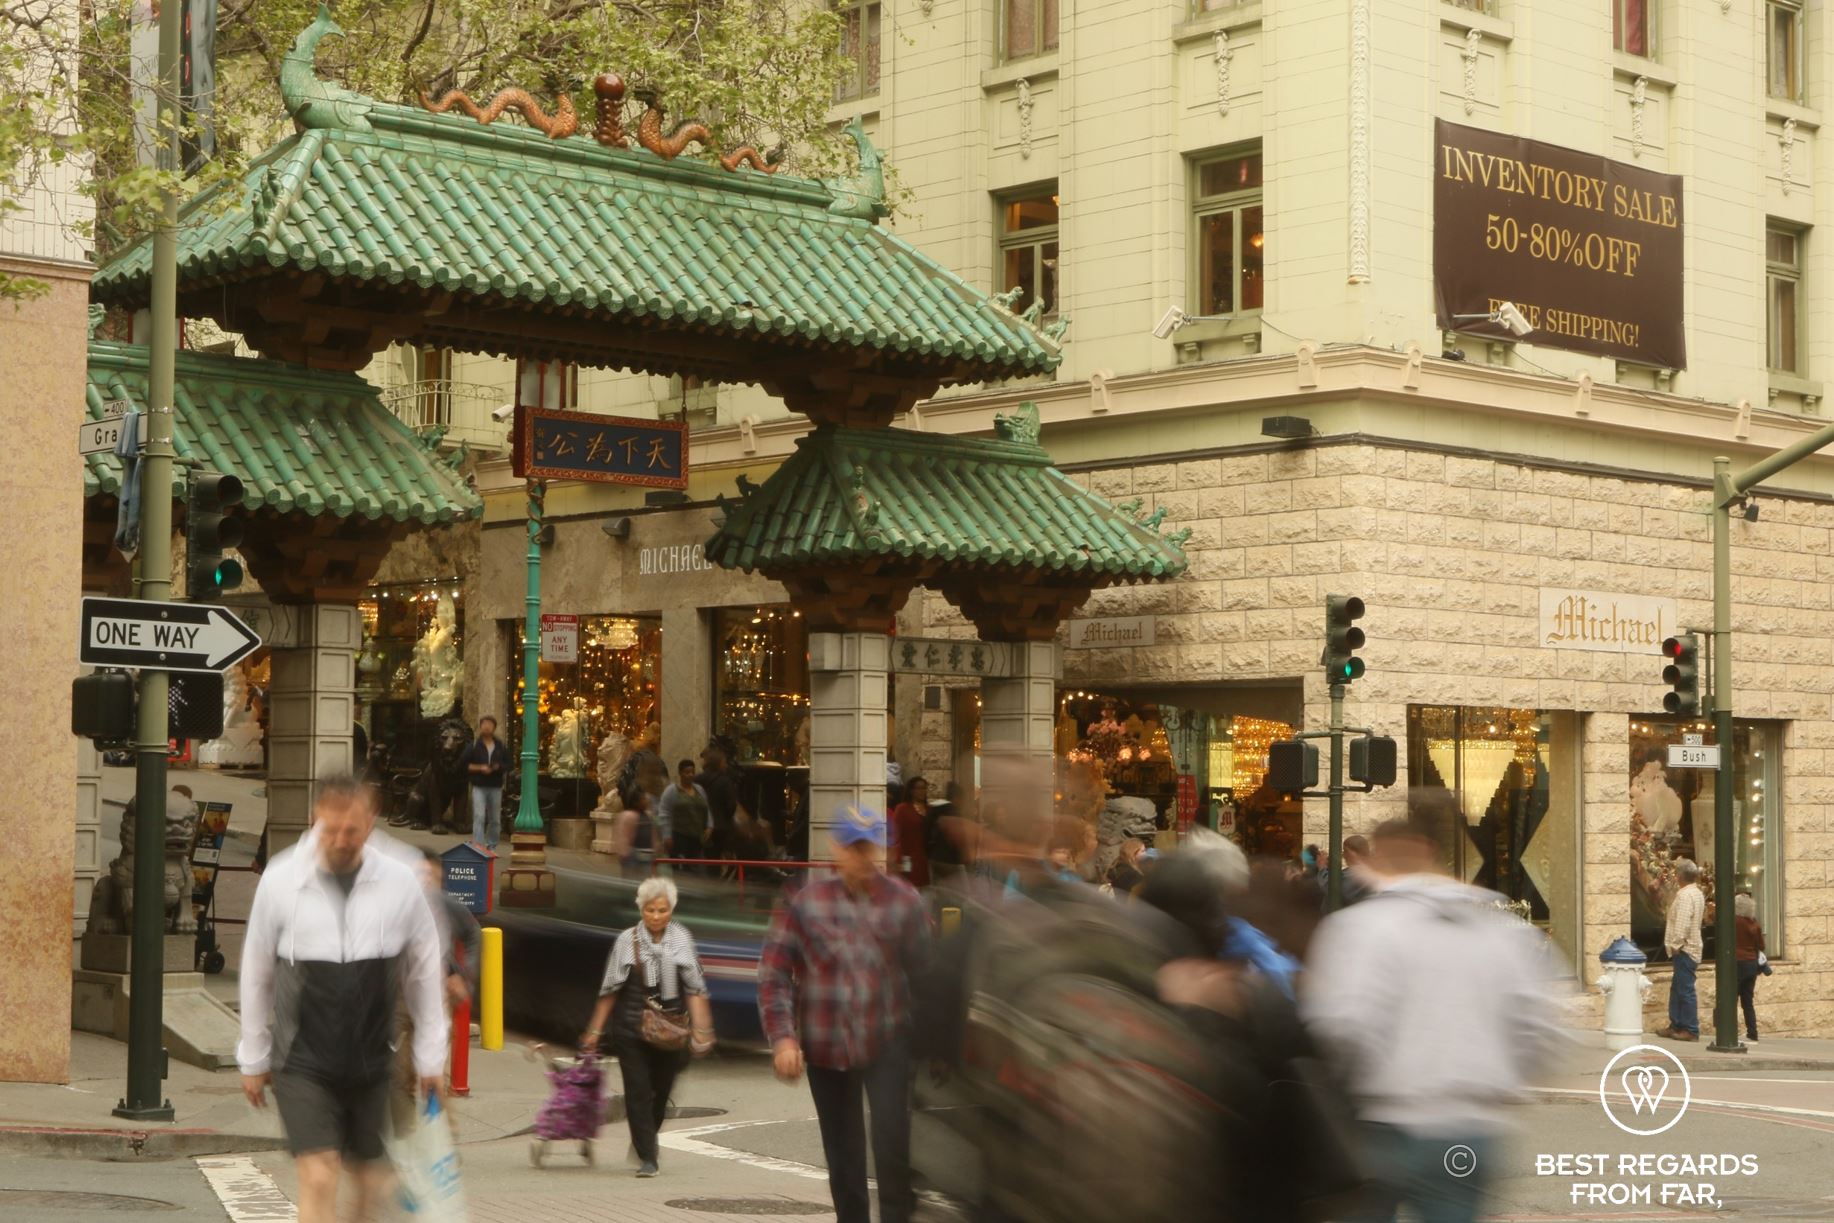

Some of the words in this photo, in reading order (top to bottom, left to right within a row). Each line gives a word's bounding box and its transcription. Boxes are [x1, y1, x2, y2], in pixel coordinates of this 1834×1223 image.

[1442, 144, 1608, 212] INVENTORY
[1614, 184, 1677, 229] SALE
[1545, 308, 1640, 348] SHIPPING!
[111, 401, 124, 415] 400
[95, 428, 122, 445] Gra
[542, 622, 553, 631] NO
[1546, 595, 1663, 645] Michael
[96, 621, 142, 646] ONE
[153, 624, 200, 649] WAY
[1081, 621, 1143, 645] Michael
[551, 644, 568, 652] TIME
[1682, 750, 1706, 762] Bush
